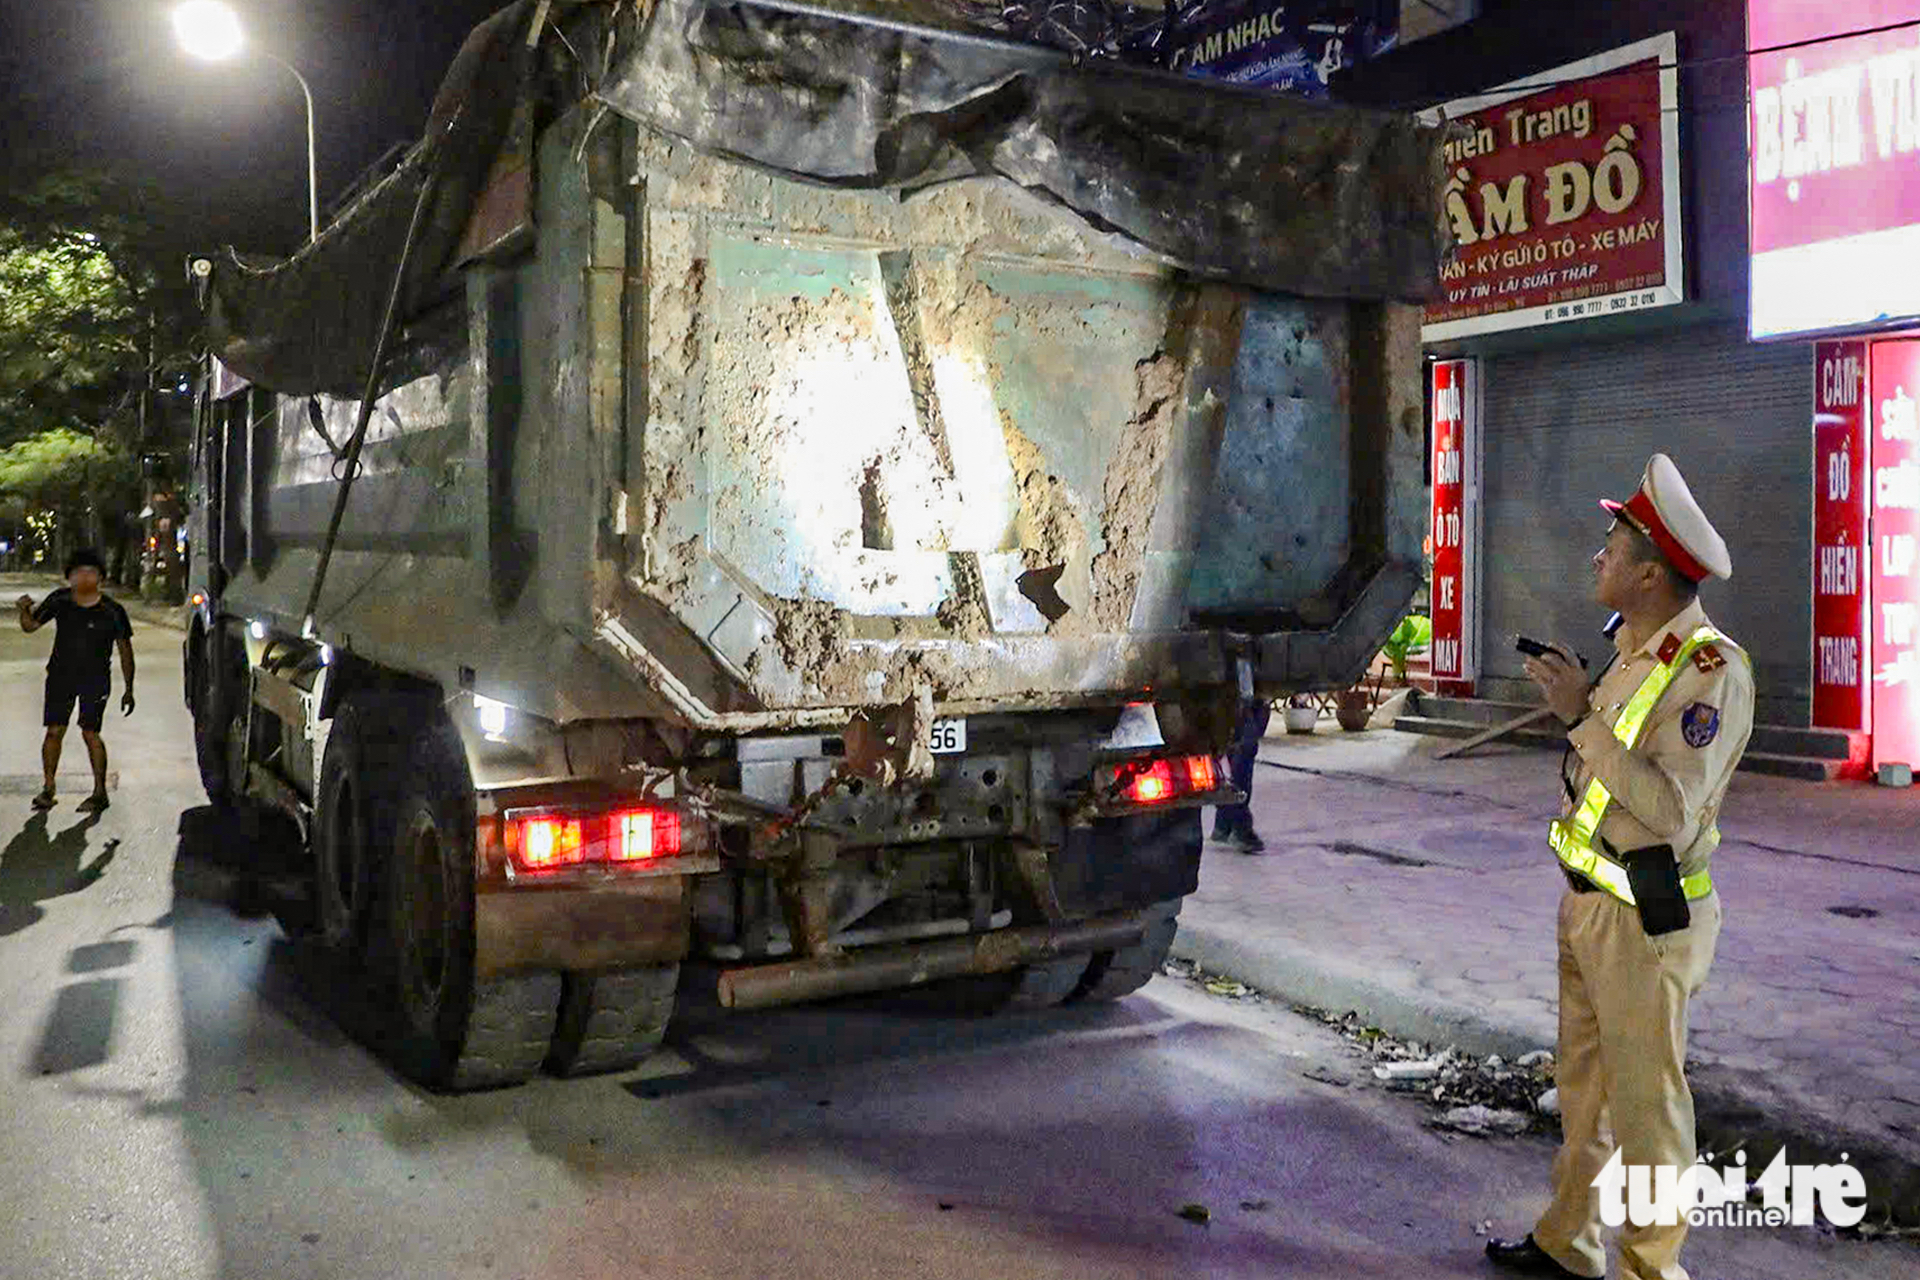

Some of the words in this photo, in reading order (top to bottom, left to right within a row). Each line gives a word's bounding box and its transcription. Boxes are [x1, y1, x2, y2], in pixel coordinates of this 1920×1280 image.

[1505, 100, 1592, 146] Trang
[1544, 123, 1640, 226] ĐỒ
[1534, 238, 1547, 262] Ô
[1552, 233, 1576, 259] TÔ
[1590, 229, 1615, 251] XE
[1618, 217, 1660, 245] MÁY
[1436, 506, 1444, 548] Ô
[1446, 506, 1460, 548] TÔ
[1440, 576, 1454, 609] XE
[1435, 632, 1458, 672] MÁY
[1819, 636, 1858, 686] TRANG
[930, 727, 956, 749] 56
